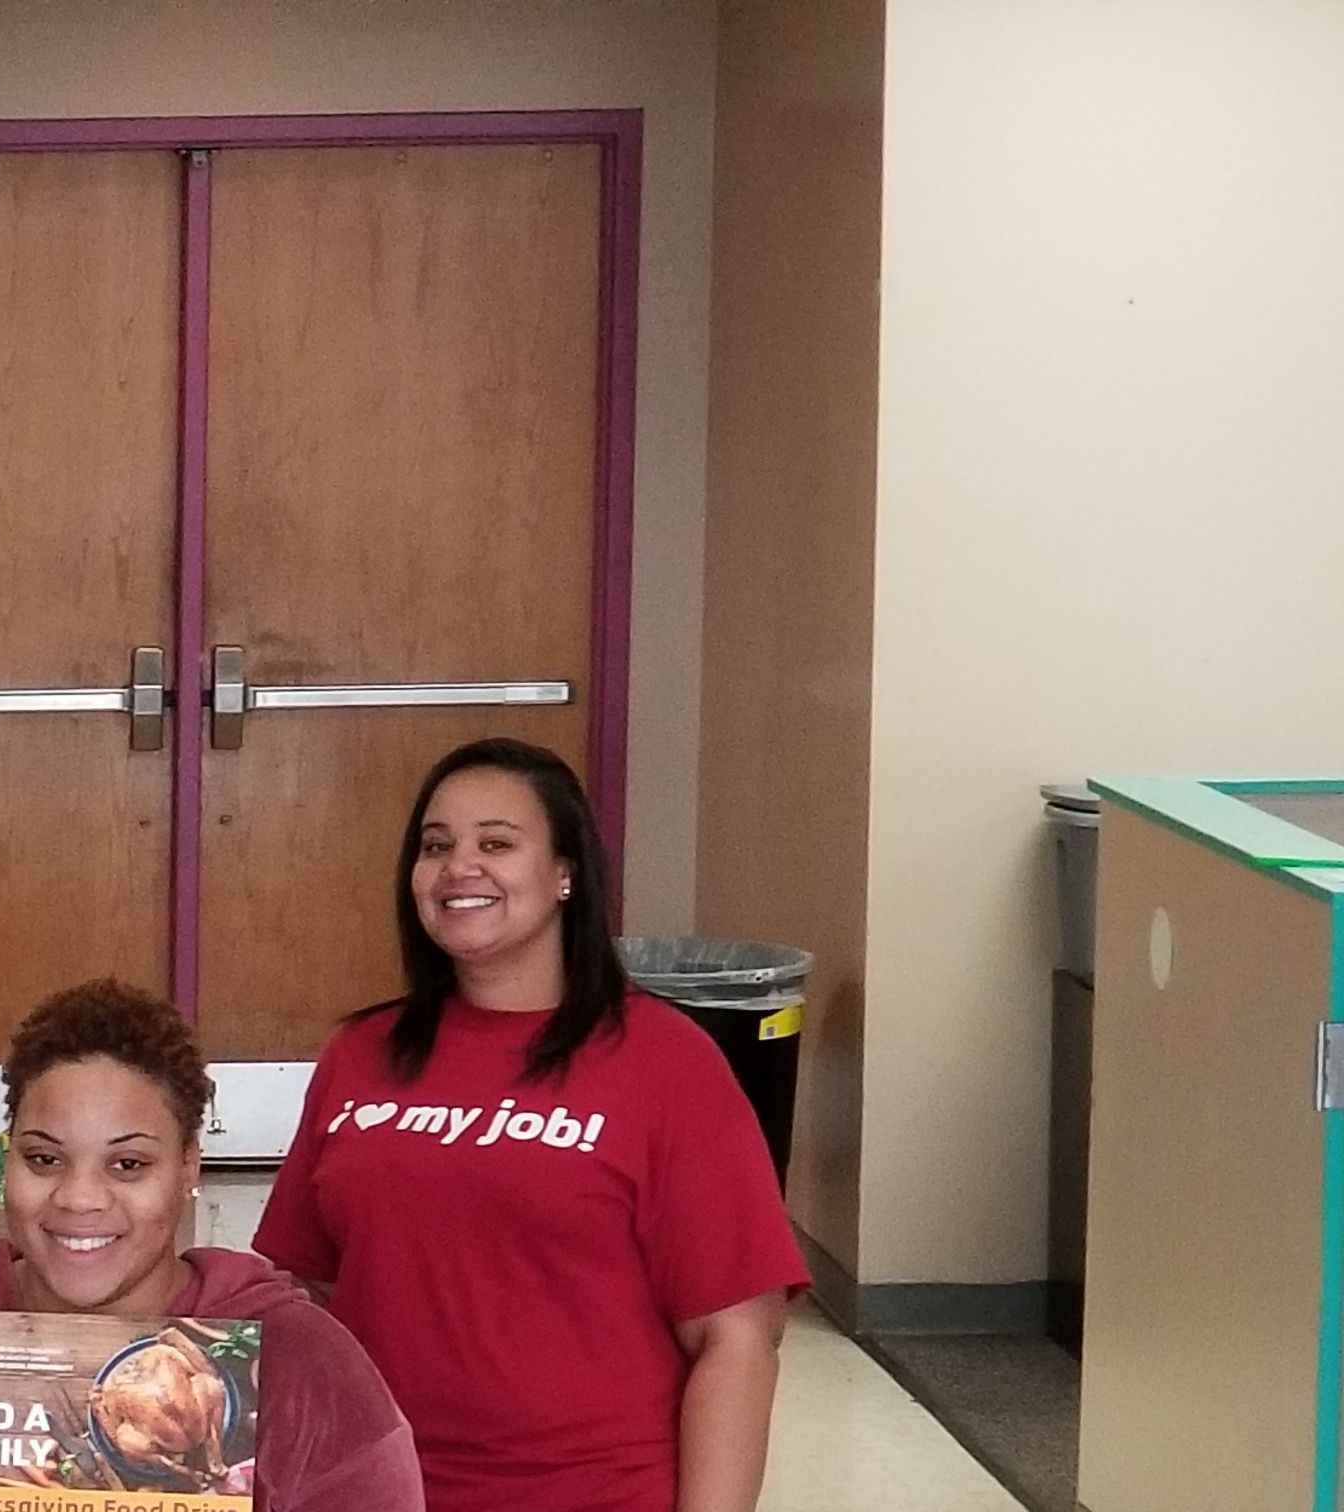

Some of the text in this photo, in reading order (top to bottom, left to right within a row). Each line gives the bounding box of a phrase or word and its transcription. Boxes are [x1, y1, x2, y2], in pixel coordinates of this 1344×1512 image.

[396, 1106, 483, 1145] my
[476, 1098, 605, 1152] job!
[23, 1403, 50, 1432] A
